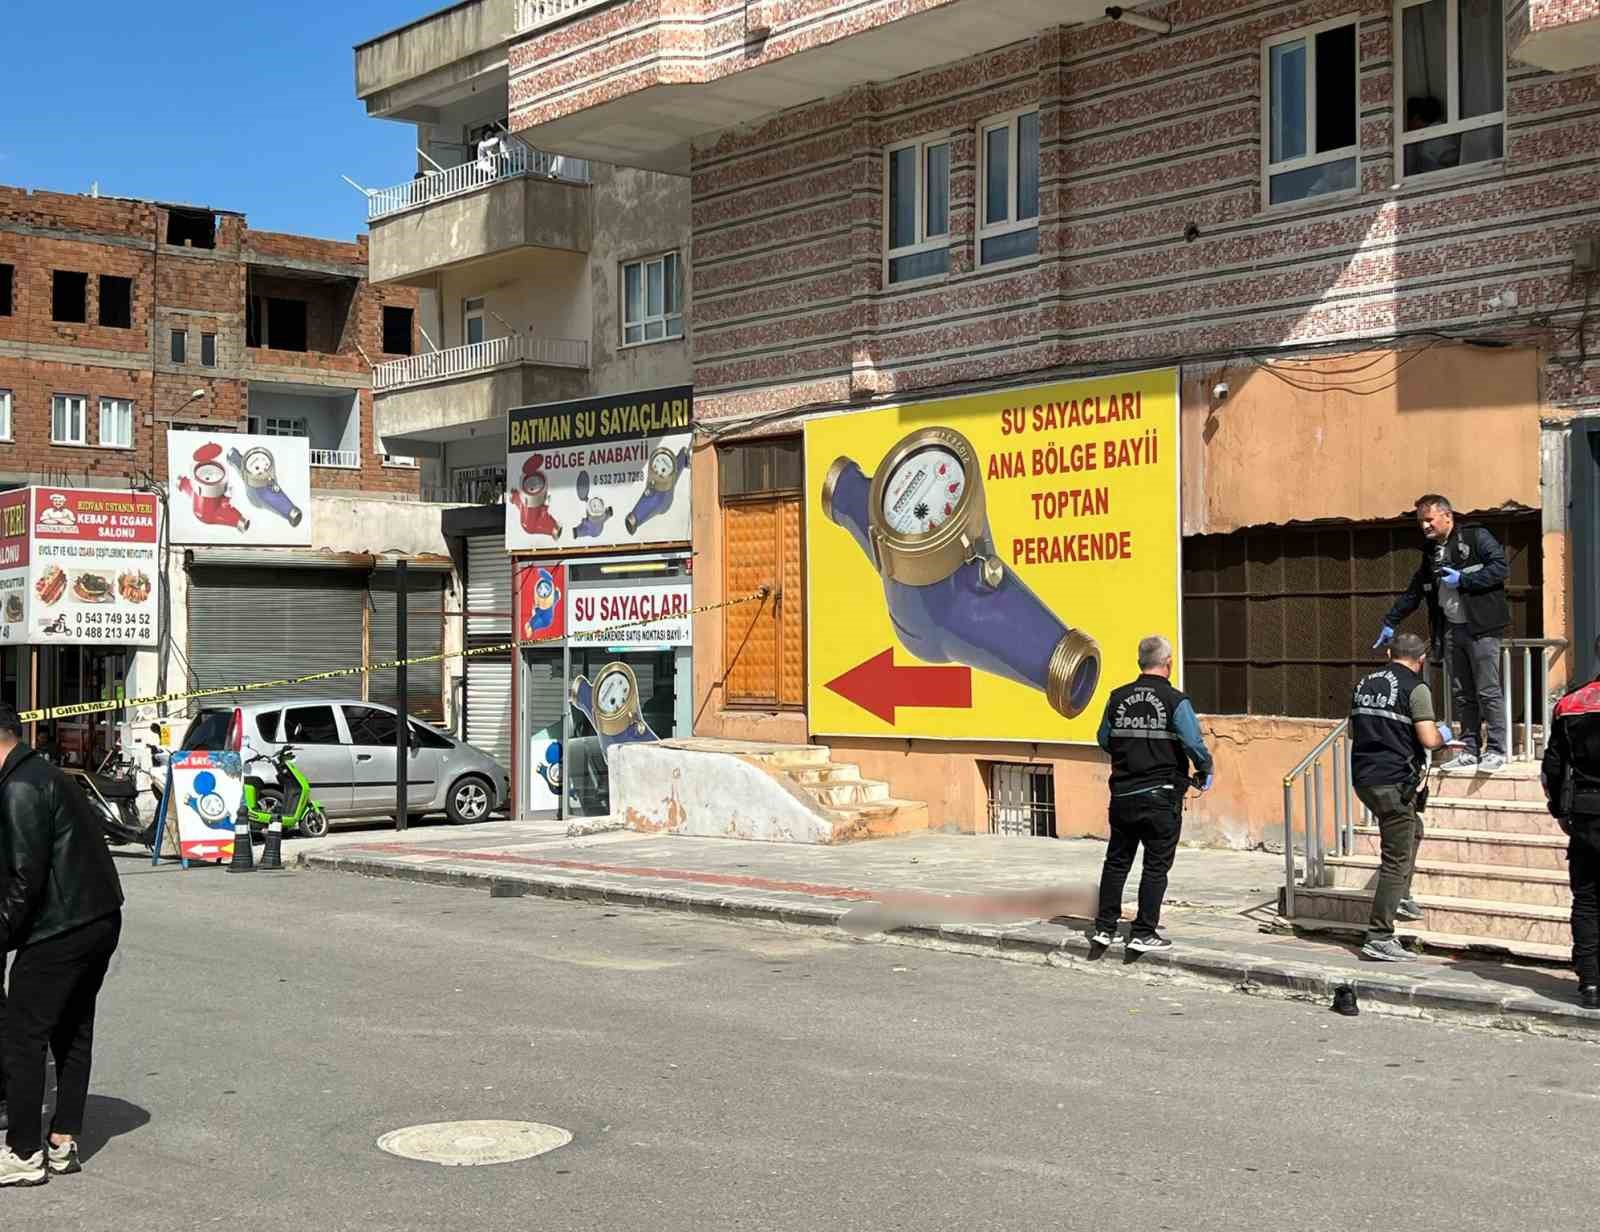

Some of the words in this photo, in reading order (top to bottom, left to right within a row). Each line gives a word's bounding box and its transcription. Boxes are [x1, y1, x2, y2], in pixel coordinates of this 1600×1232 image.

[511, 415, 571, 446] BATMAN
[576, 411, 596, 438] SU
[600, 398, 688, 437] SAYAÇLARI
[1001, 407, 1026, 436] SU
[1032, 391, 1142, 432] SAYACLARI
[987, 451, 1026, 480] ANA
[1032, 441, 1097, 476] BÖLGE
[1104, 428, 1158, 469] BAYİİ
[1032, 487, 1109, 520] TOPTAN
[77, 514, 108, 525] KEBAP
[111, 515, 117, 526] &
[120, 515, 153, 527] IZGARA
[98, 527, 135, 538] SALONU
[1012, 531, 1131, 565] PERAKENDE
[76, 612, 82, 624] 0
[84, 612, 102, 624] 543
[105, 613, 122, 625] 749
[125, 613, 136, 625] 34
[138, 613, 150, 625] 52
[575, 596, 596, 622] SU
[76, 627, 82, 638] 0
[84, 627, 102, 639] 488
[105, 627, 122, 639] 213
[124, 627, 136, 639] 47
[138, 627, 150, 639] 48
